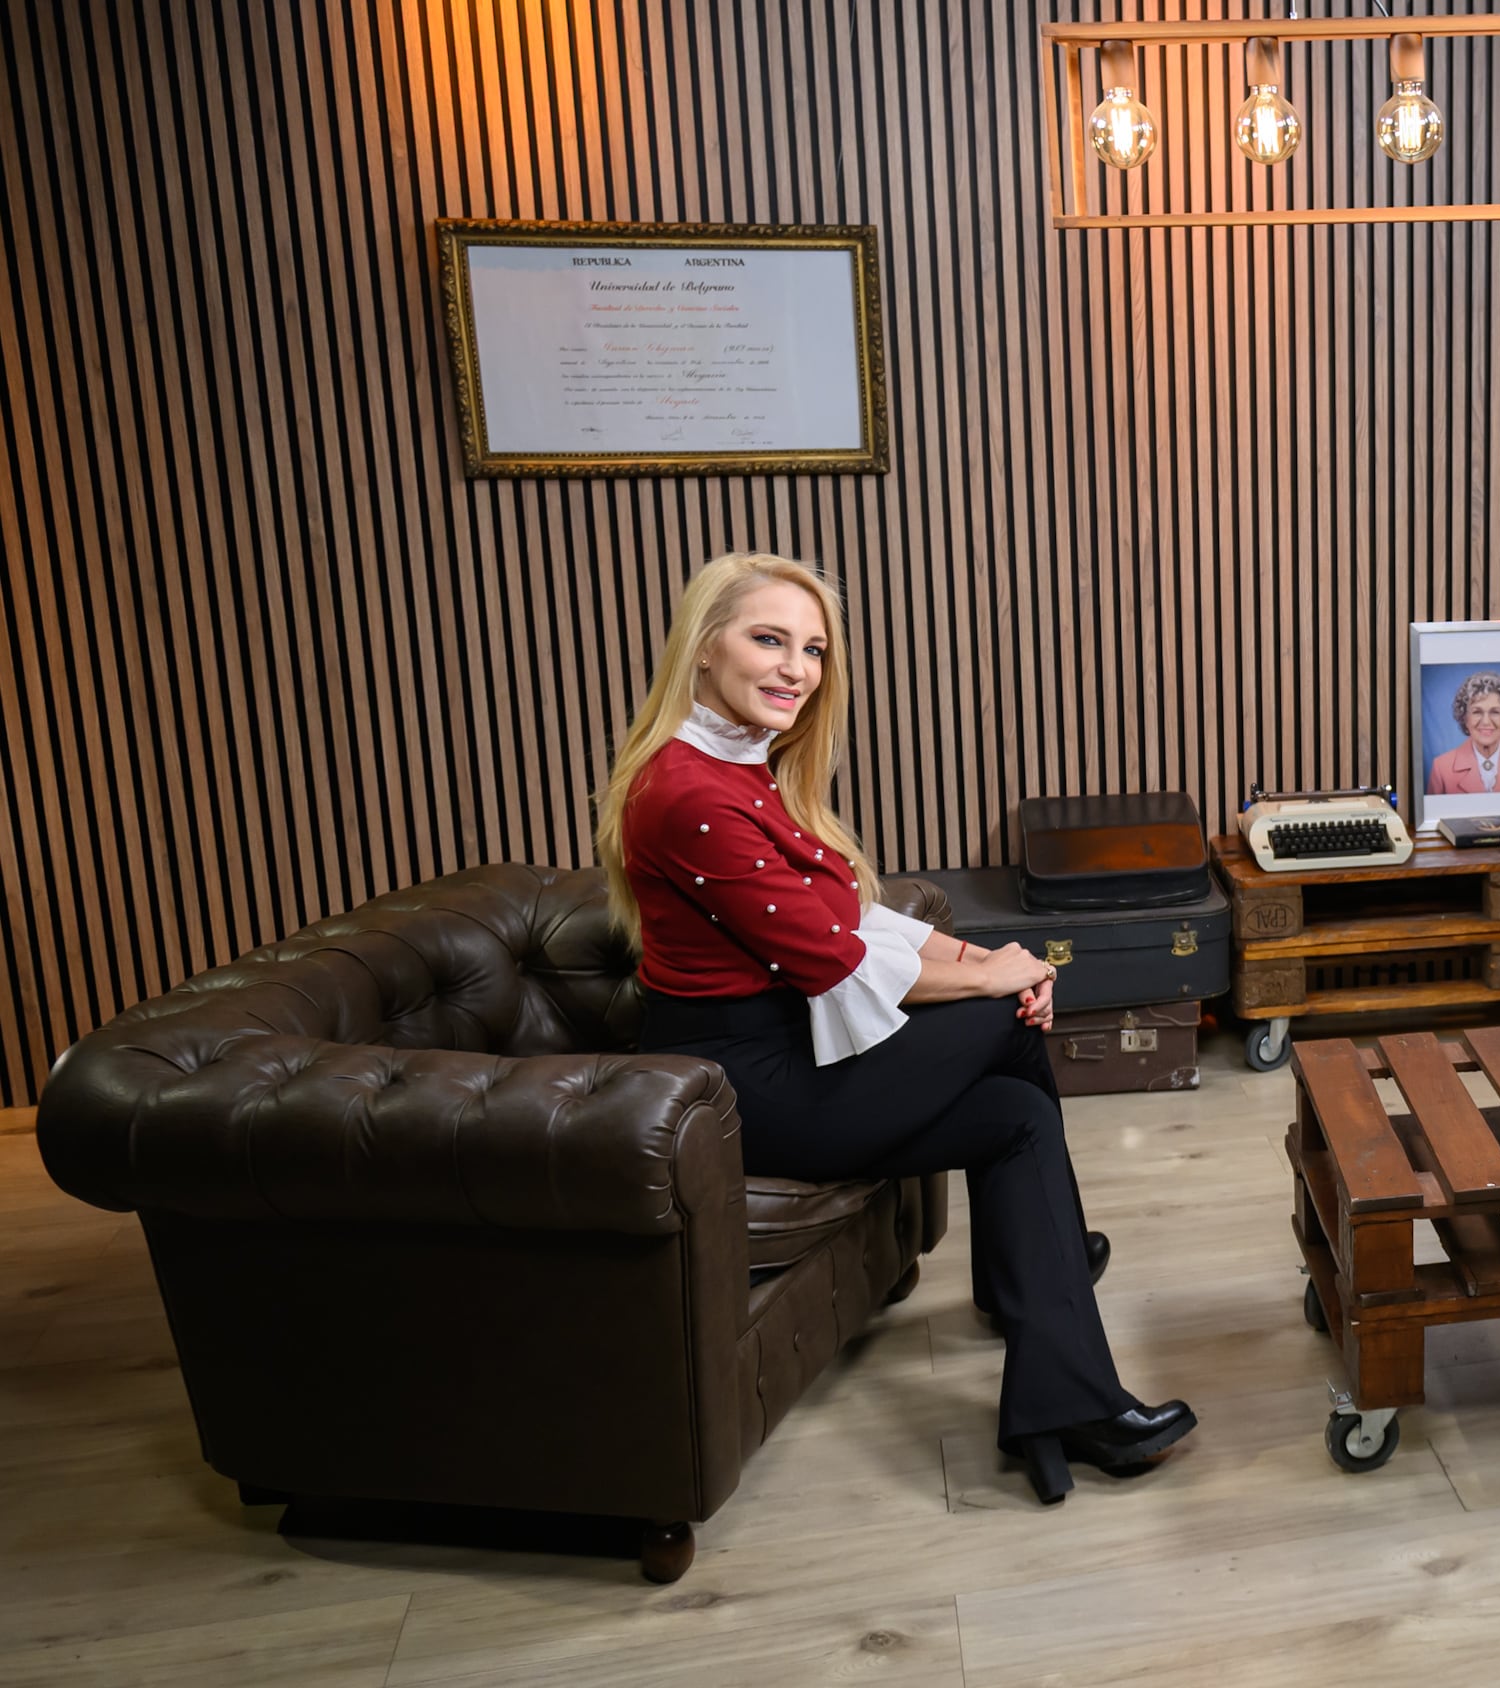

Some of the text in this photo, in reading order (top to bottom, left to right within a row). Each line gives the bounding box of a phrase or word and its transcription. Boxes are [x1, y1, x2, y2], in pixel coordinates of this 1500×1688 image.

[572, 257, 745, 267] REPUBLICA ARGENTINA
[589, 280, 735, 295] Universidad de Belgrano
[1255, 907, 1287, 929] EPAL
